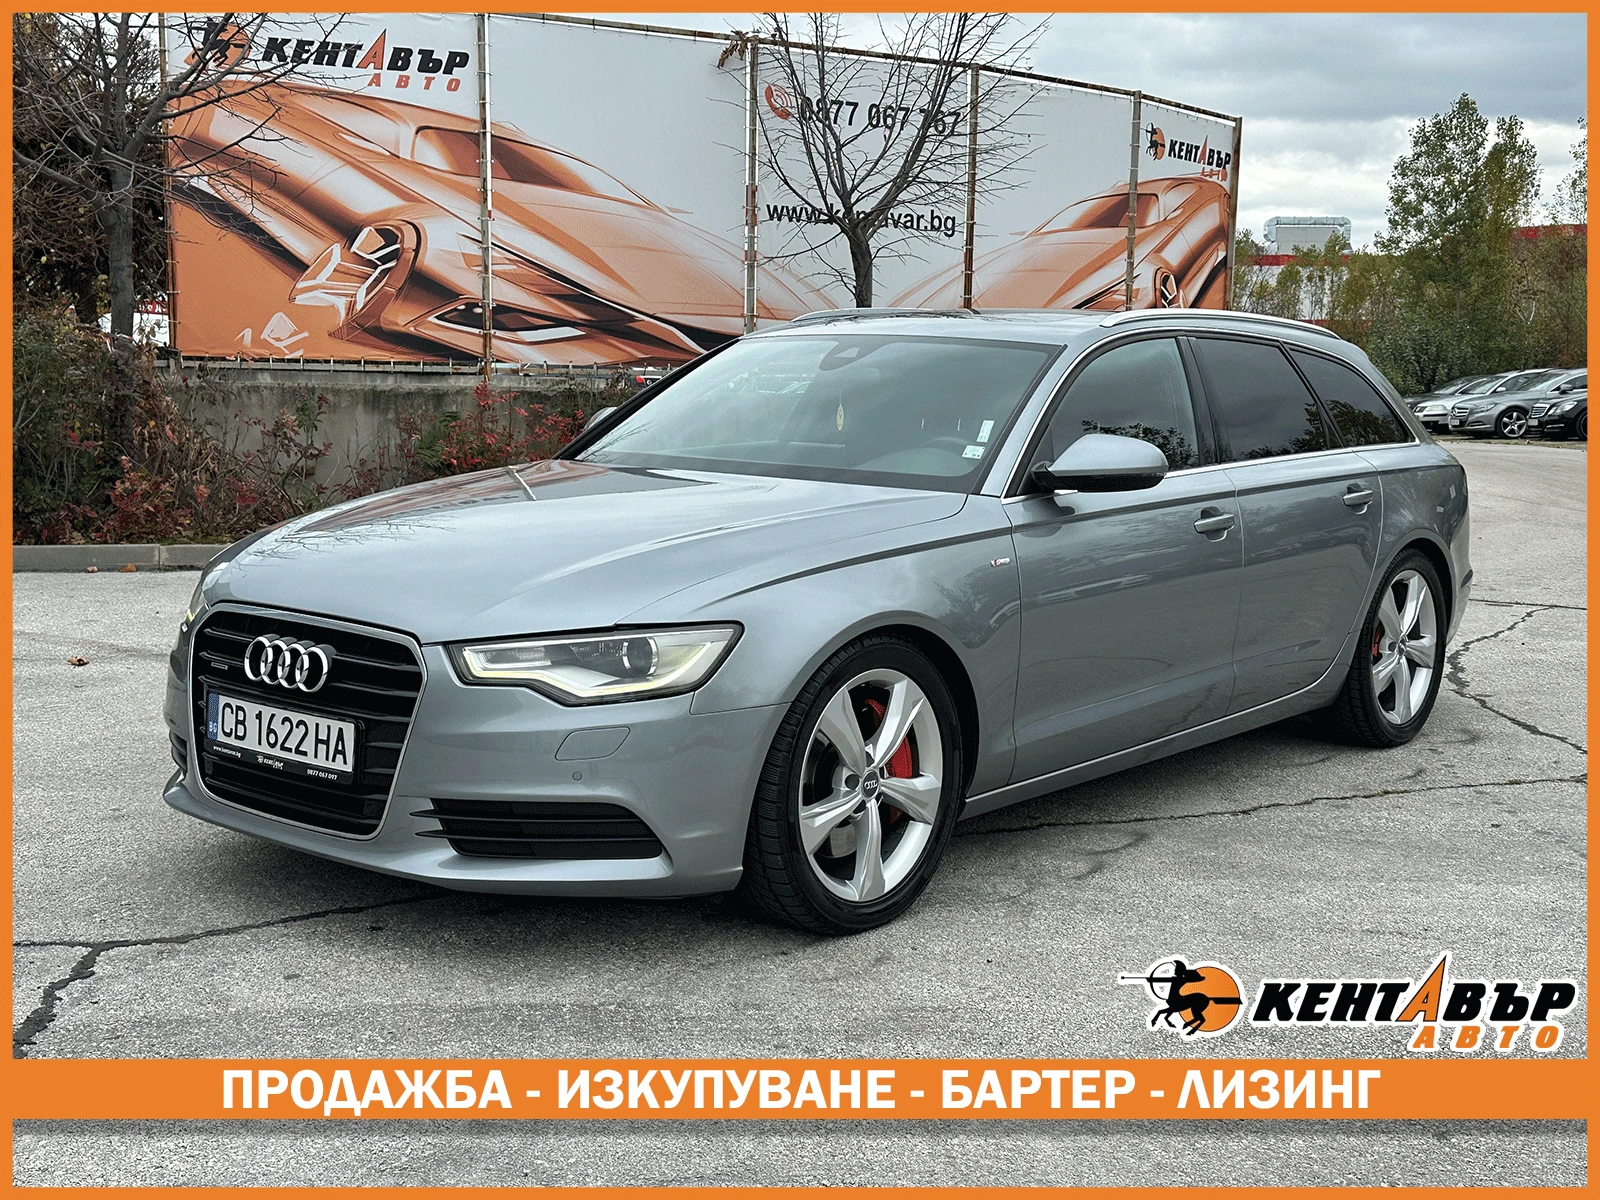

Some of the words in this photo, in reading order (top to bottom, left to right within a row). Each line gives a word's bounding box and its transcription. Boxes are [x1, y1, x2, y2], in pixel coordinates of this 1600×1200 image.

[262, 28, 470, 76] КЕНТАВЪР
[368, 73, 461, 93] АВТО
[1168, 134, 1231, 169] КЕНТАВЪР
[221, 702, 247, 741] CB
[255, 709, 309, 757] 1622
[314, 722, 348, 765] HA
